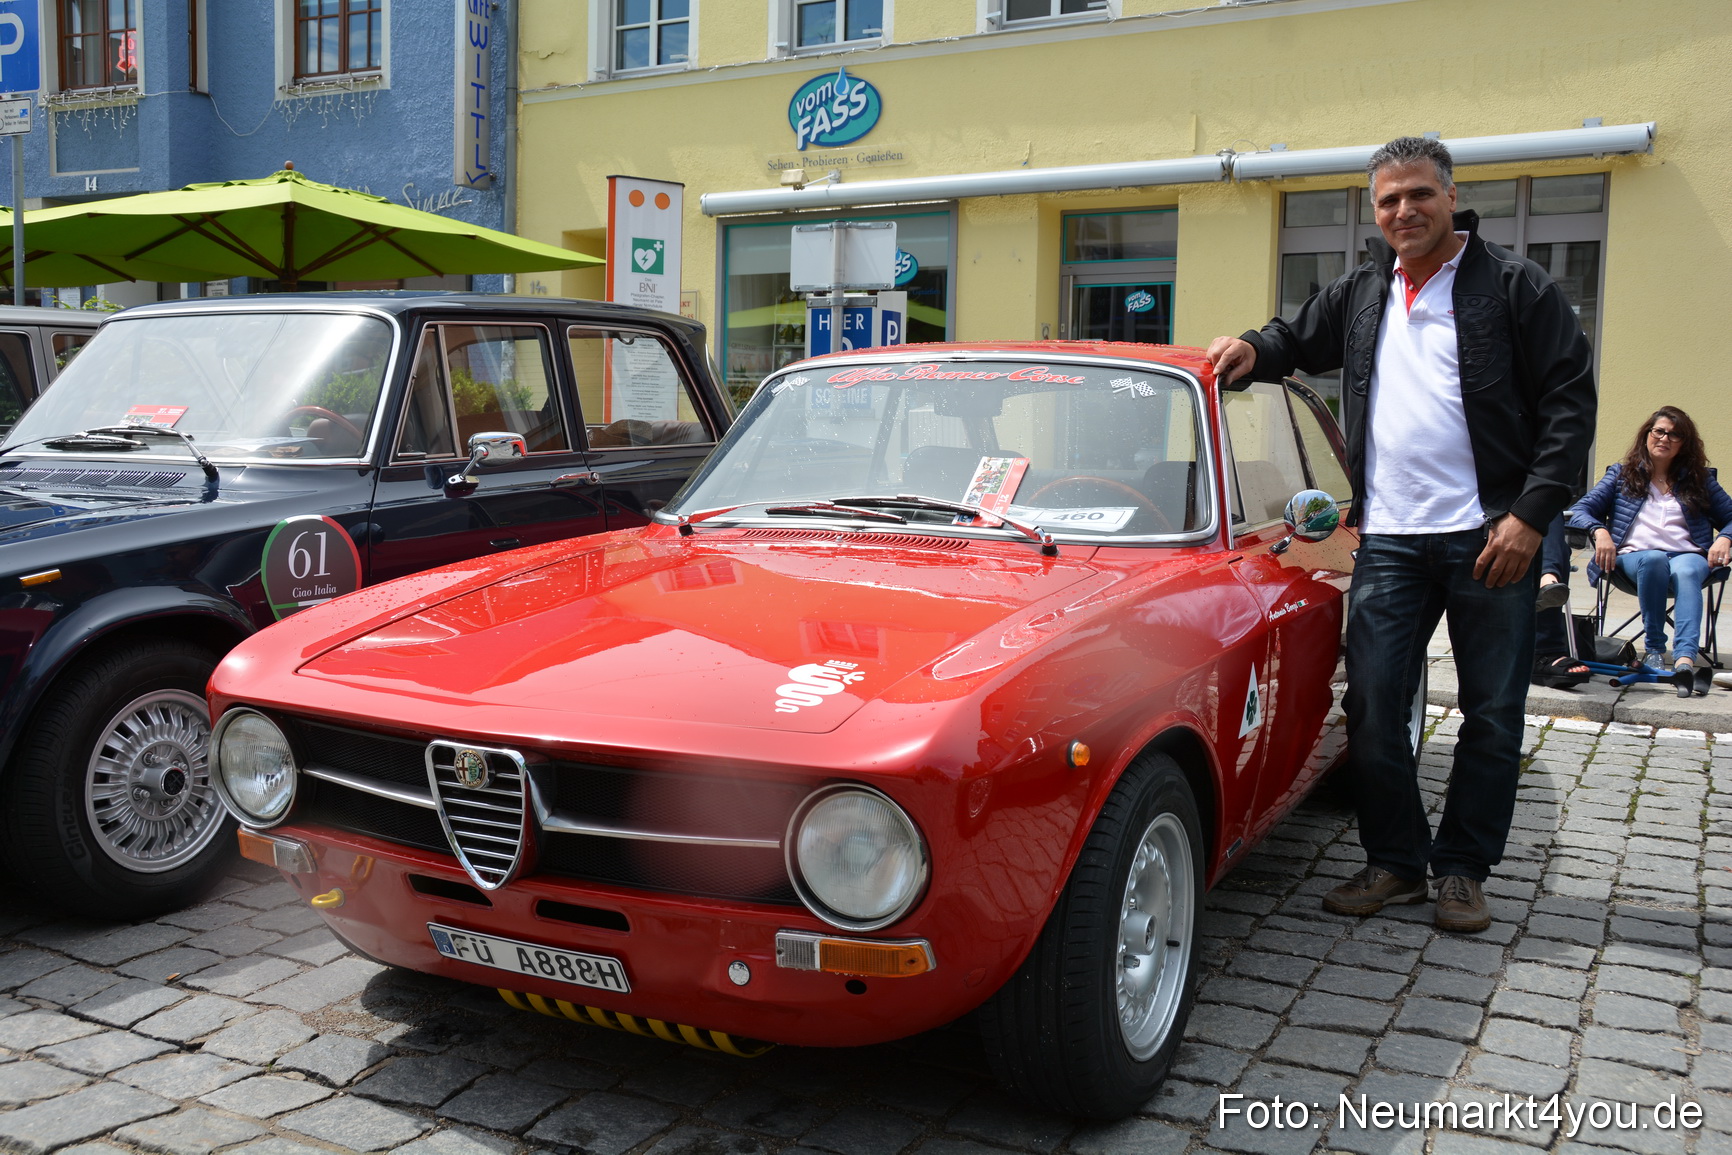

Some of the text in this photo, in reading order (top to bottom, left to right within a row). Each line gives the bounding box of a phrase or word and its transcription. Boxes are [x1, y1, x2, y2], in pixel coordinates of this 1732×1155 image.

[796, 81, 831, 116] vom
[797, 81, 867, 150] FASS
[767, 150, 903, 171] Sehen Probieren Genießen
[85, 176, 98, 191] 14
[1127, 294, 1151, 312] FASS
[1128, 292, 1140, 302] vom
[819, 313, 865, 331] HER
[827, 364, 1085, 389] Alfa Romeo Corse
[1053, 512, 1105, 521] 460
[288, 531, 331, 579] 61
[292, 584, 337, 598] Ciao Italia
[450, 933, 495, 965] FÜ
[516, 946, 622, 989] A888H
